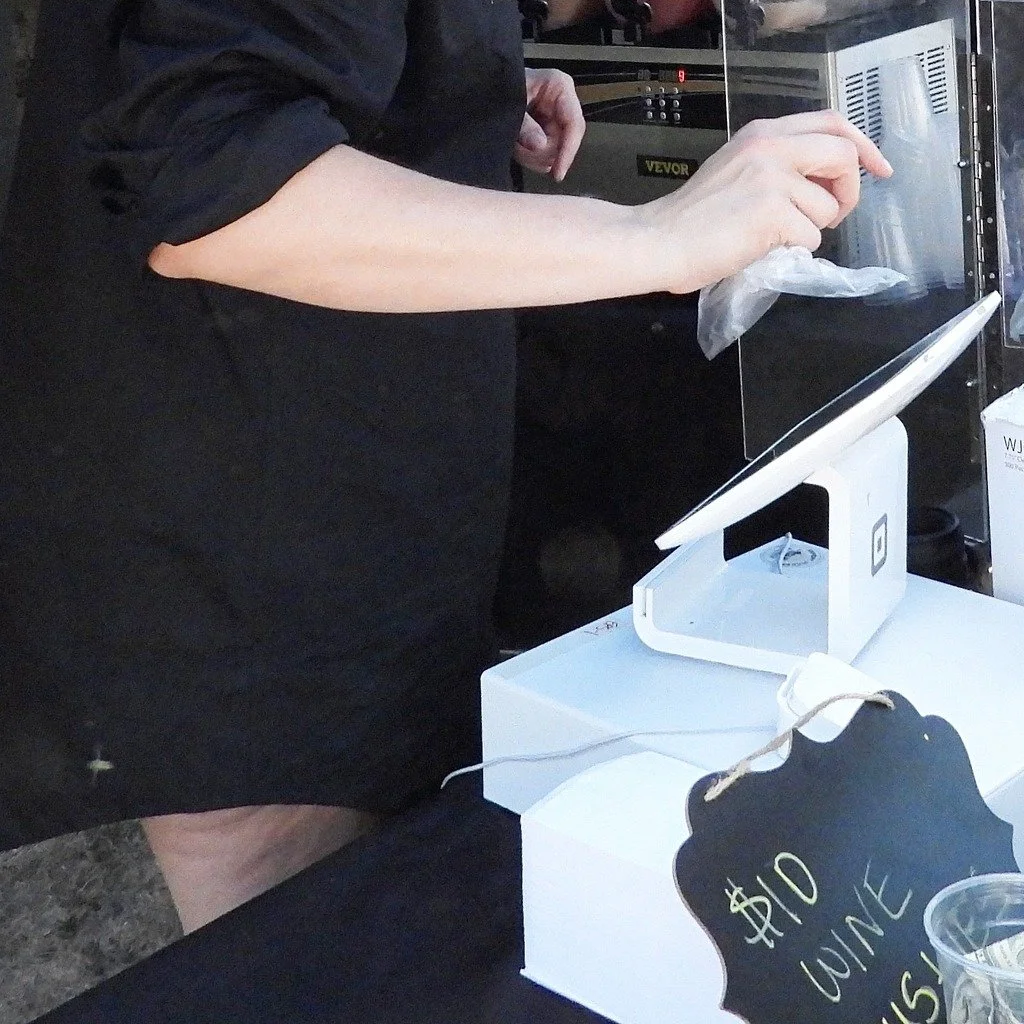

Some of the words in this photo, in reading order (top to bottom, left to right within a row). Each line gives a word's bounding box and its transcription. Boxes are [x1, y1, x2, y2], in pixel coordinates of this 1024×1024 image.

[645, 159, 689, 176] VEVOR
[724, 851, 819, 948] $10
[799, 859, 913, 1004] WINE
